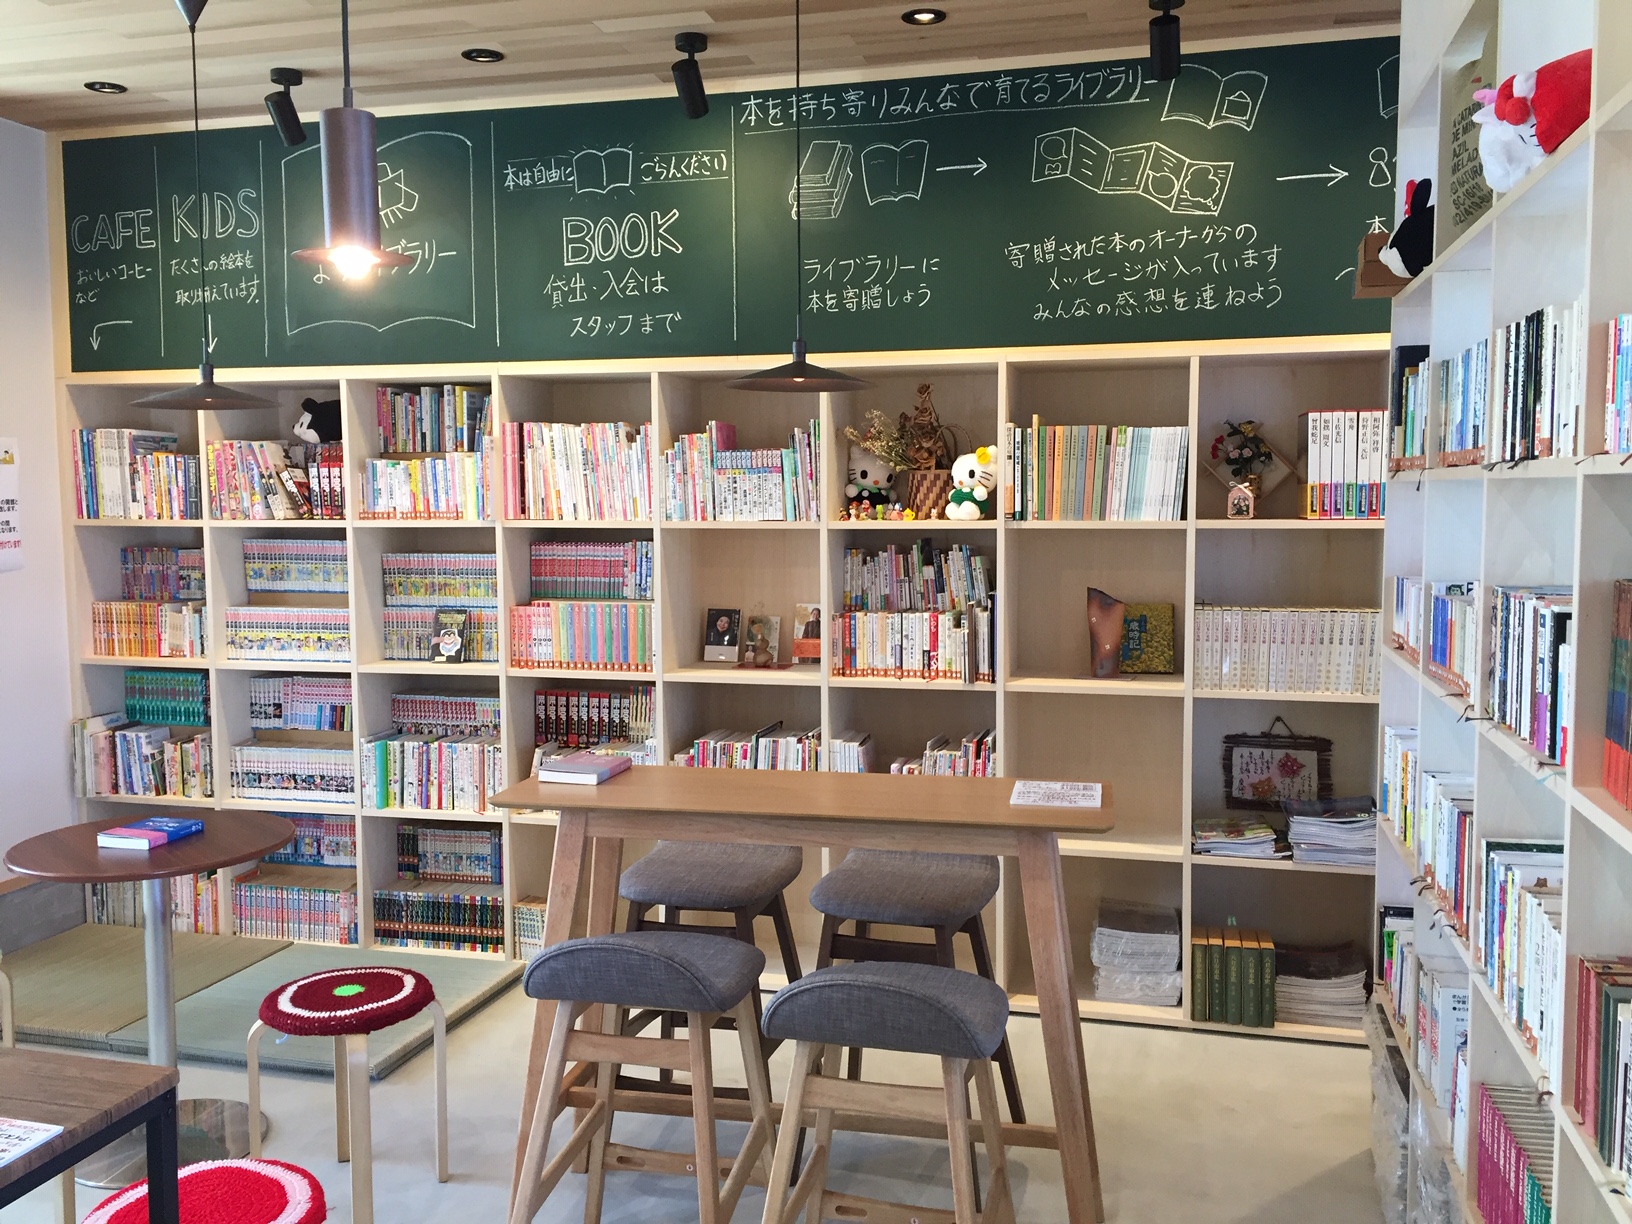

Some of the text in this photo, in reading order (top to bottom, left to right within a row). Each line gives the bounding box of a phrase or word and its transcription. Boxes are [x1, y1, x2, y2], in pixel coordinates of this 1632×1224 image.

[739, 65, 1158, 127] 本を持ち寄りみんなで育てるライブラリー
[503, 152, 728, 191] 本は自由に ごらんください
[71, 208, 156, 254] CAFE
[171, 188, 260, 242] KIDS
[563, 208, 683, 266] BOOK
[1004, 223, 1258, 269] 寄贈された本のオーナーからの
[77, 262, 153, 285] おいしいコーヒー
[169, 249, 254, 276] たくさの絵本を
[803, 254, 940, 285] ライブラリーに
[1047, 244, 1282, 292] メッセージが入っています
[75, 288, 99, 304] など
[1032, 279, 1283, 322] みんなの感想を連ねよう
[570, 311, 683, 338] スタッフまで
[1128, 621, 1141, 649] 歳時記
